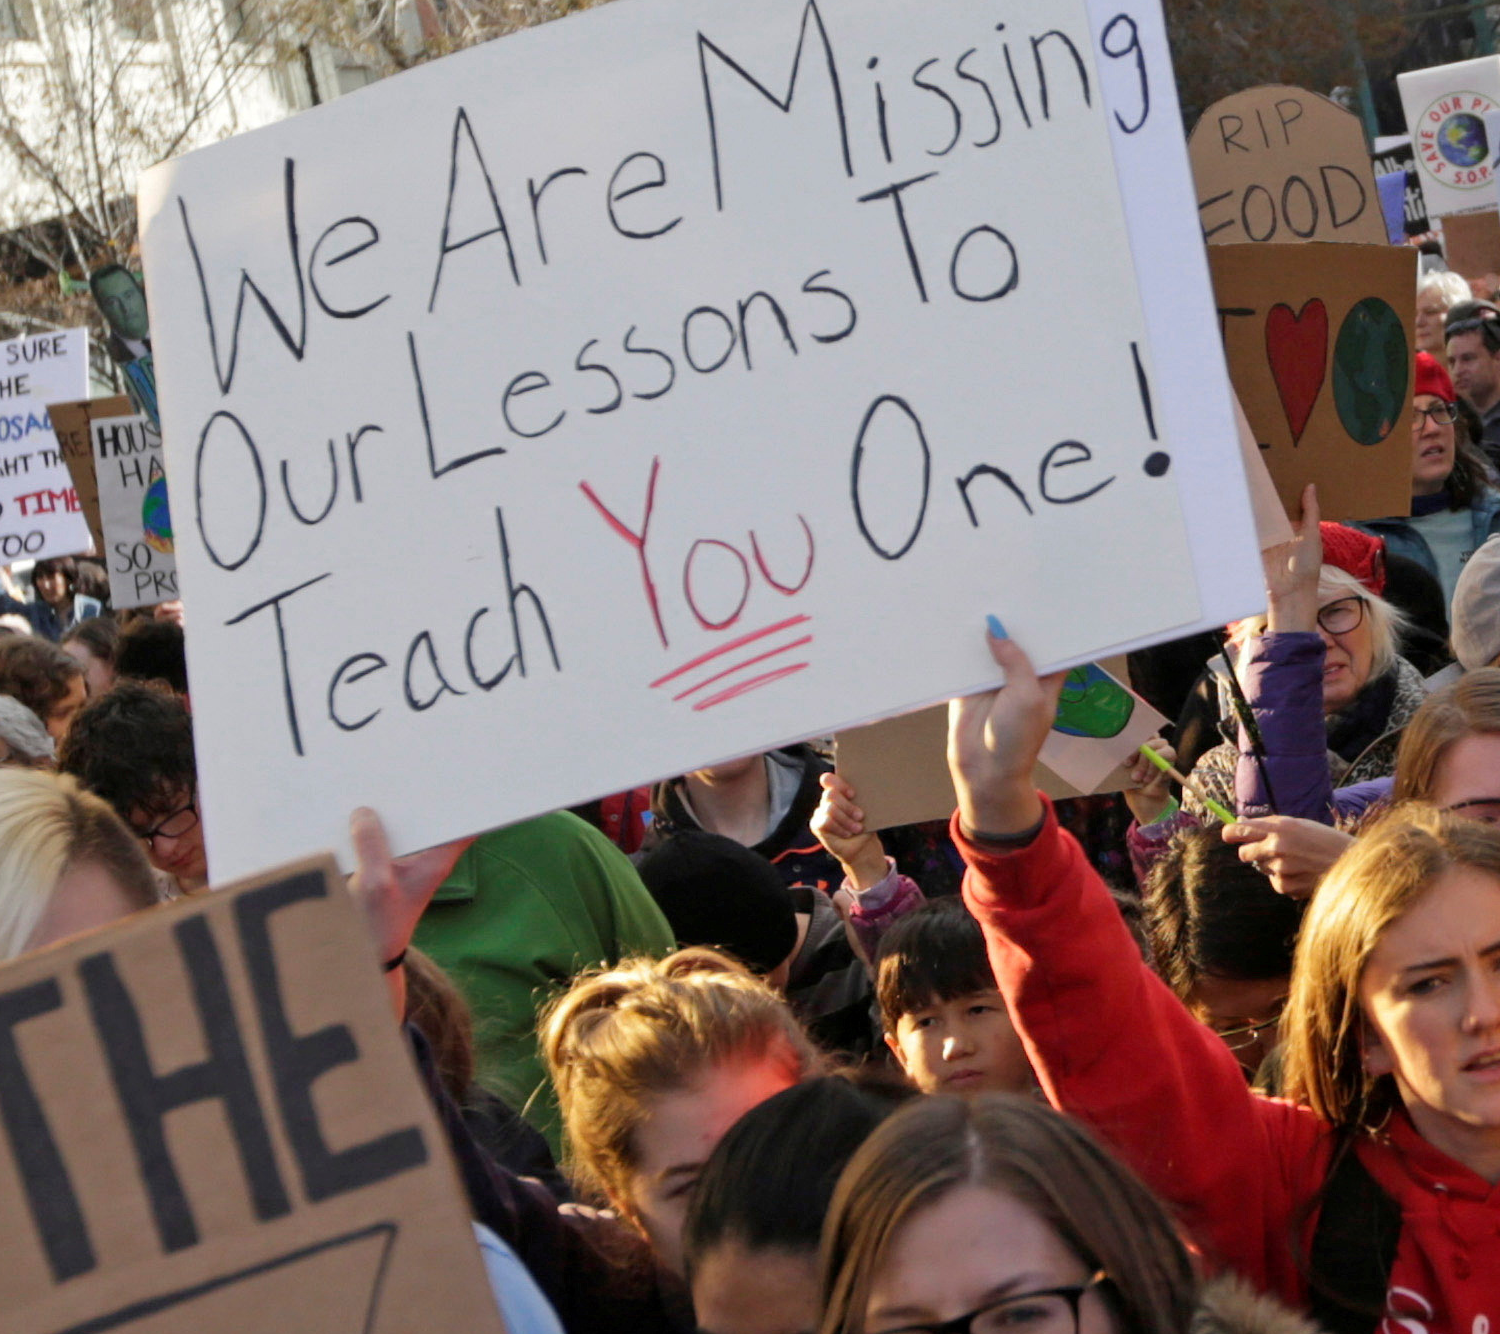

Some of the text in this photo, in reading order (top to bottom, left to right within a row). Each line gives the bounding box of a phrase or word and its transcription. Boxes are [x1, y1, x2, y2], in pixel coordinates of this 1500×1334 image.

[1219, 99, 1303, 153] RIP
[1429, 96, 1463, 123] OUR
[1420, 130, 1446, 174] SAVE
[1199, 165, 1366, 242] FOOD
[181, 157, 390, 395] We
[429, 107, 682, 313] Are
[6, 334, 67, 366] SURE
[193, 172, 1021, 571] Our Lessons To
[41, 449, 66, 469] TH
[97, 423, 162, 459] HOUS
[119, 456, 165, 489] HA
[13, 488, 83, 519] TIME
[114, 542, 152, 574] SO
[227, 508, 562, 756] Teach
[851, 343, 1174, 561] One!
